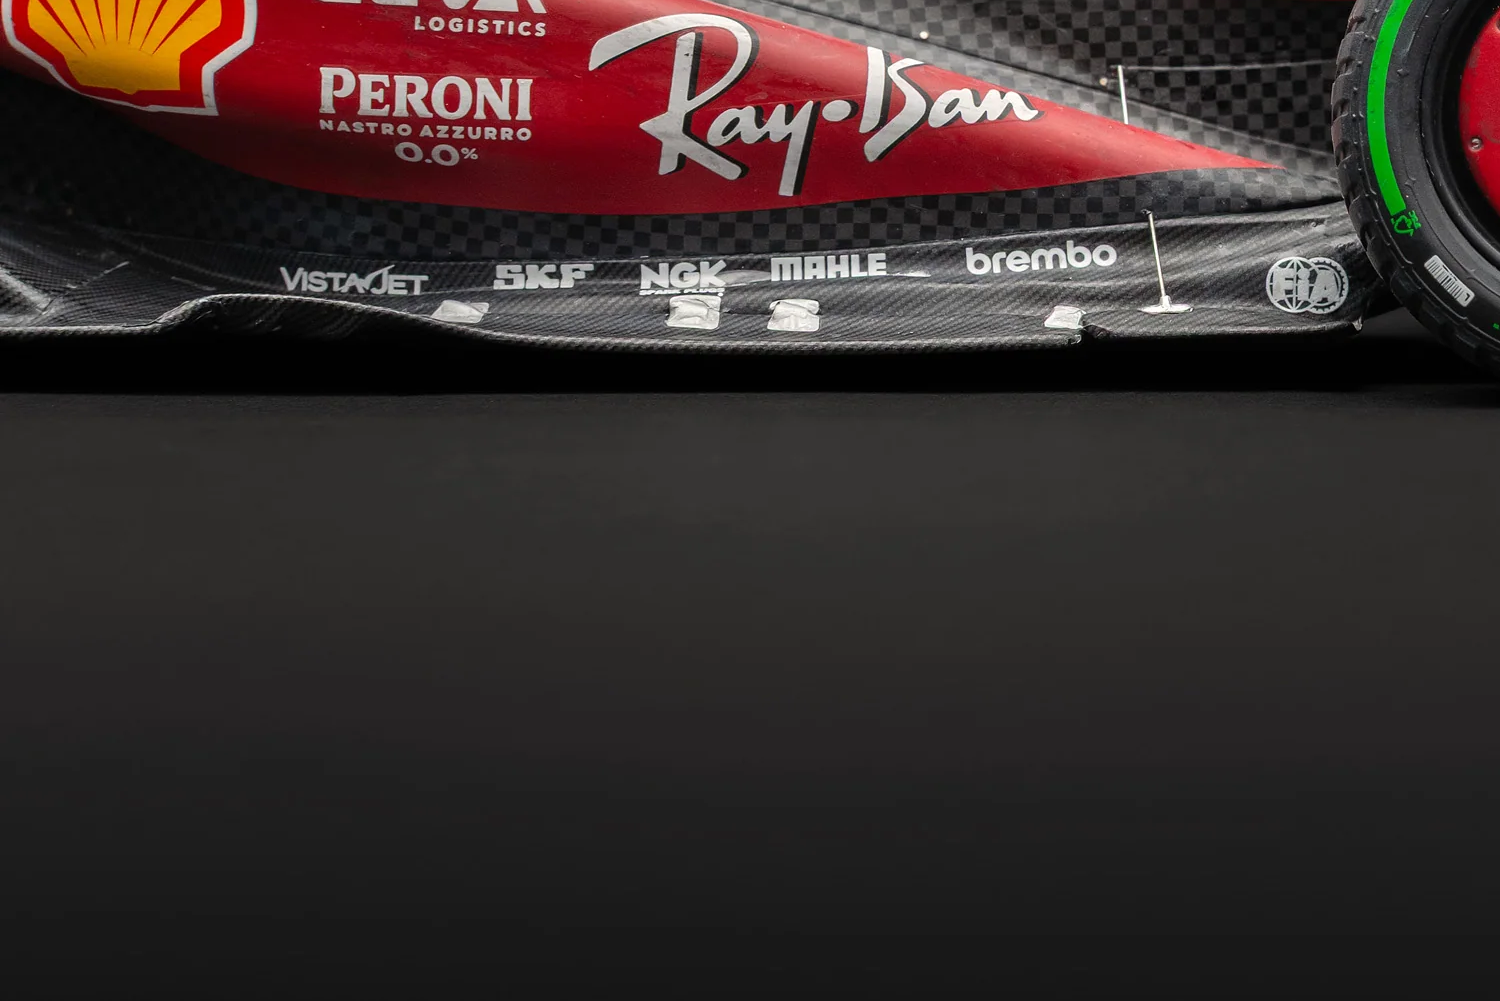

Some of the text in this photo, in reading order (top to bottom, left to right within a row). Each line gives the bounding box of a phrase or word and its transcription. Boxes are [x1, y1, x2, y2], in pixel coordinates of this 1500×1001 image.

[414, 15, 546, 37] LOGISTICS
[318, 66, 534, 121] PERONI
[318, 119, 532, 141] NASTRO AZZURRO
[394, 141, 479, 167] 0.0%
[770, 253, 887, 282] MAHLE
[965, 240, 1117, 275] brembo
[493, 263, 594, 290] SKF
[639, 259, 727, 288] NGK
